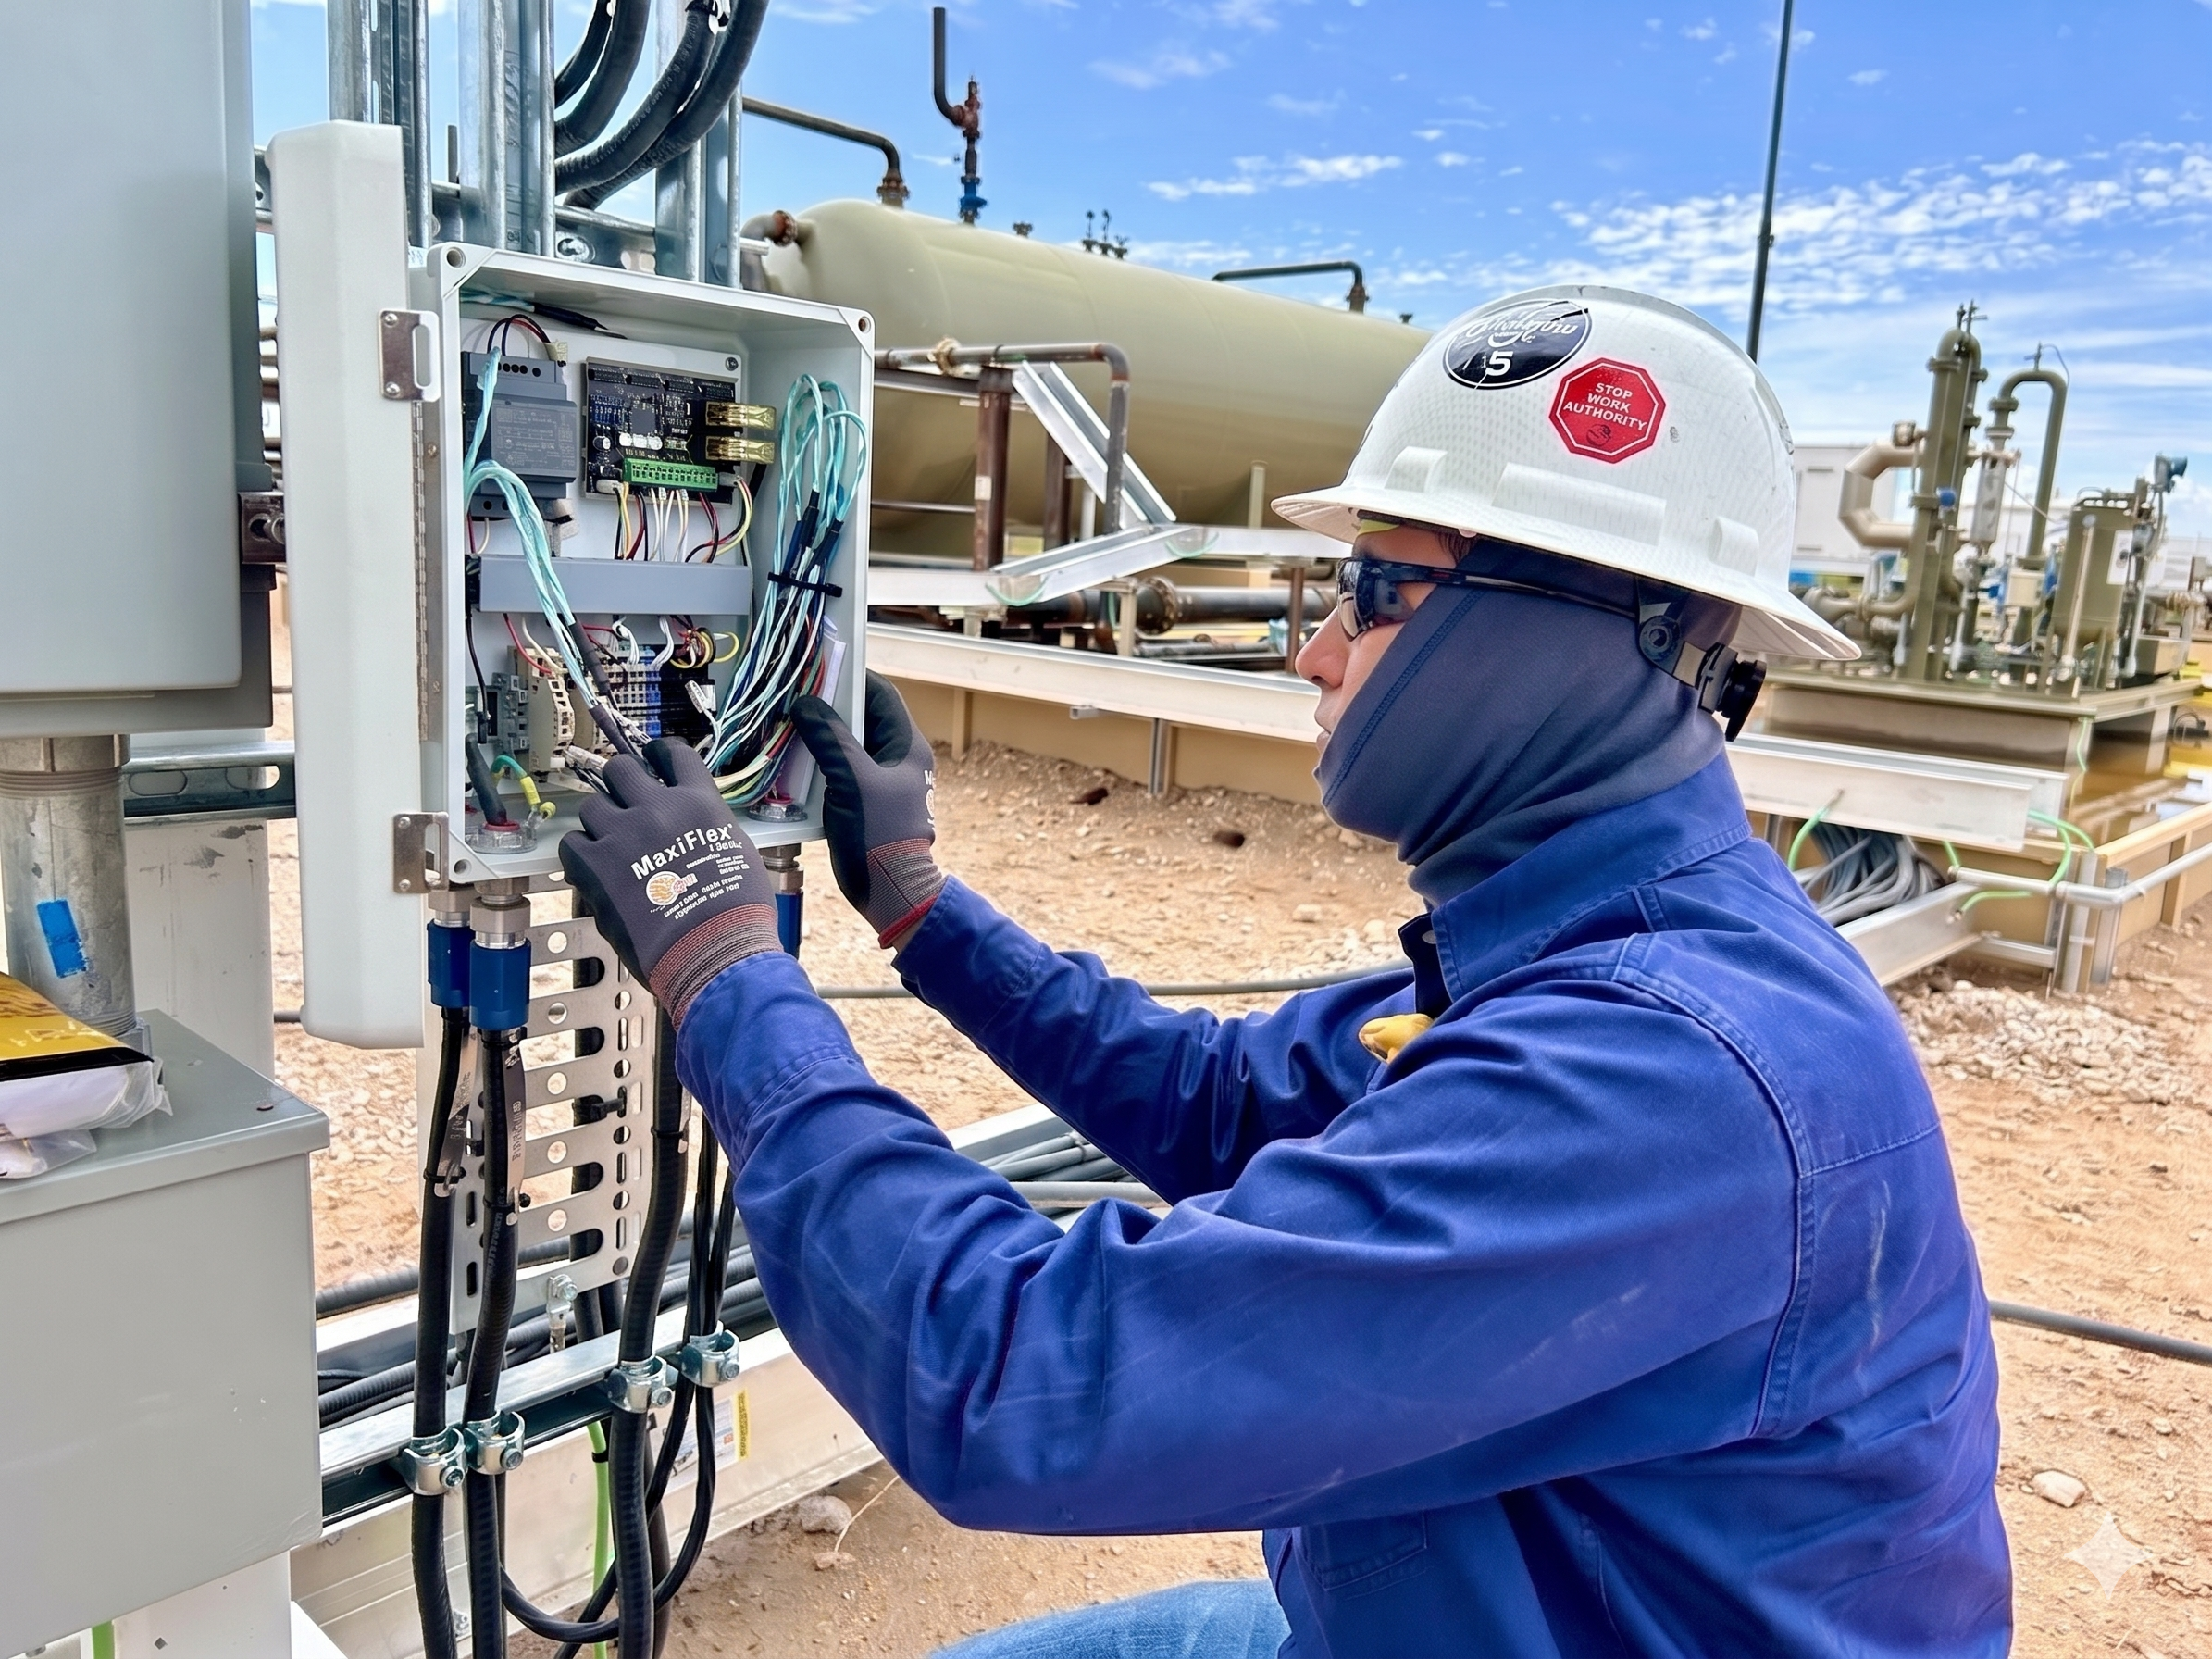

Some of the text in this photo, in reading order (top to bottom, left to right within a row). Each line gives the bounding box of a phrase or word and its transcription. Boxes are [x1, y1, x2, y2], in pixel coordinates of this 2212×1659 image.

[1595, 382, 1633, 399] STOP
[1587, 393, 1631, 413] WORK
[1563, 401, 1647, 430] AUTHORITY
[630, 826, 731, 880] MaxiFlex
